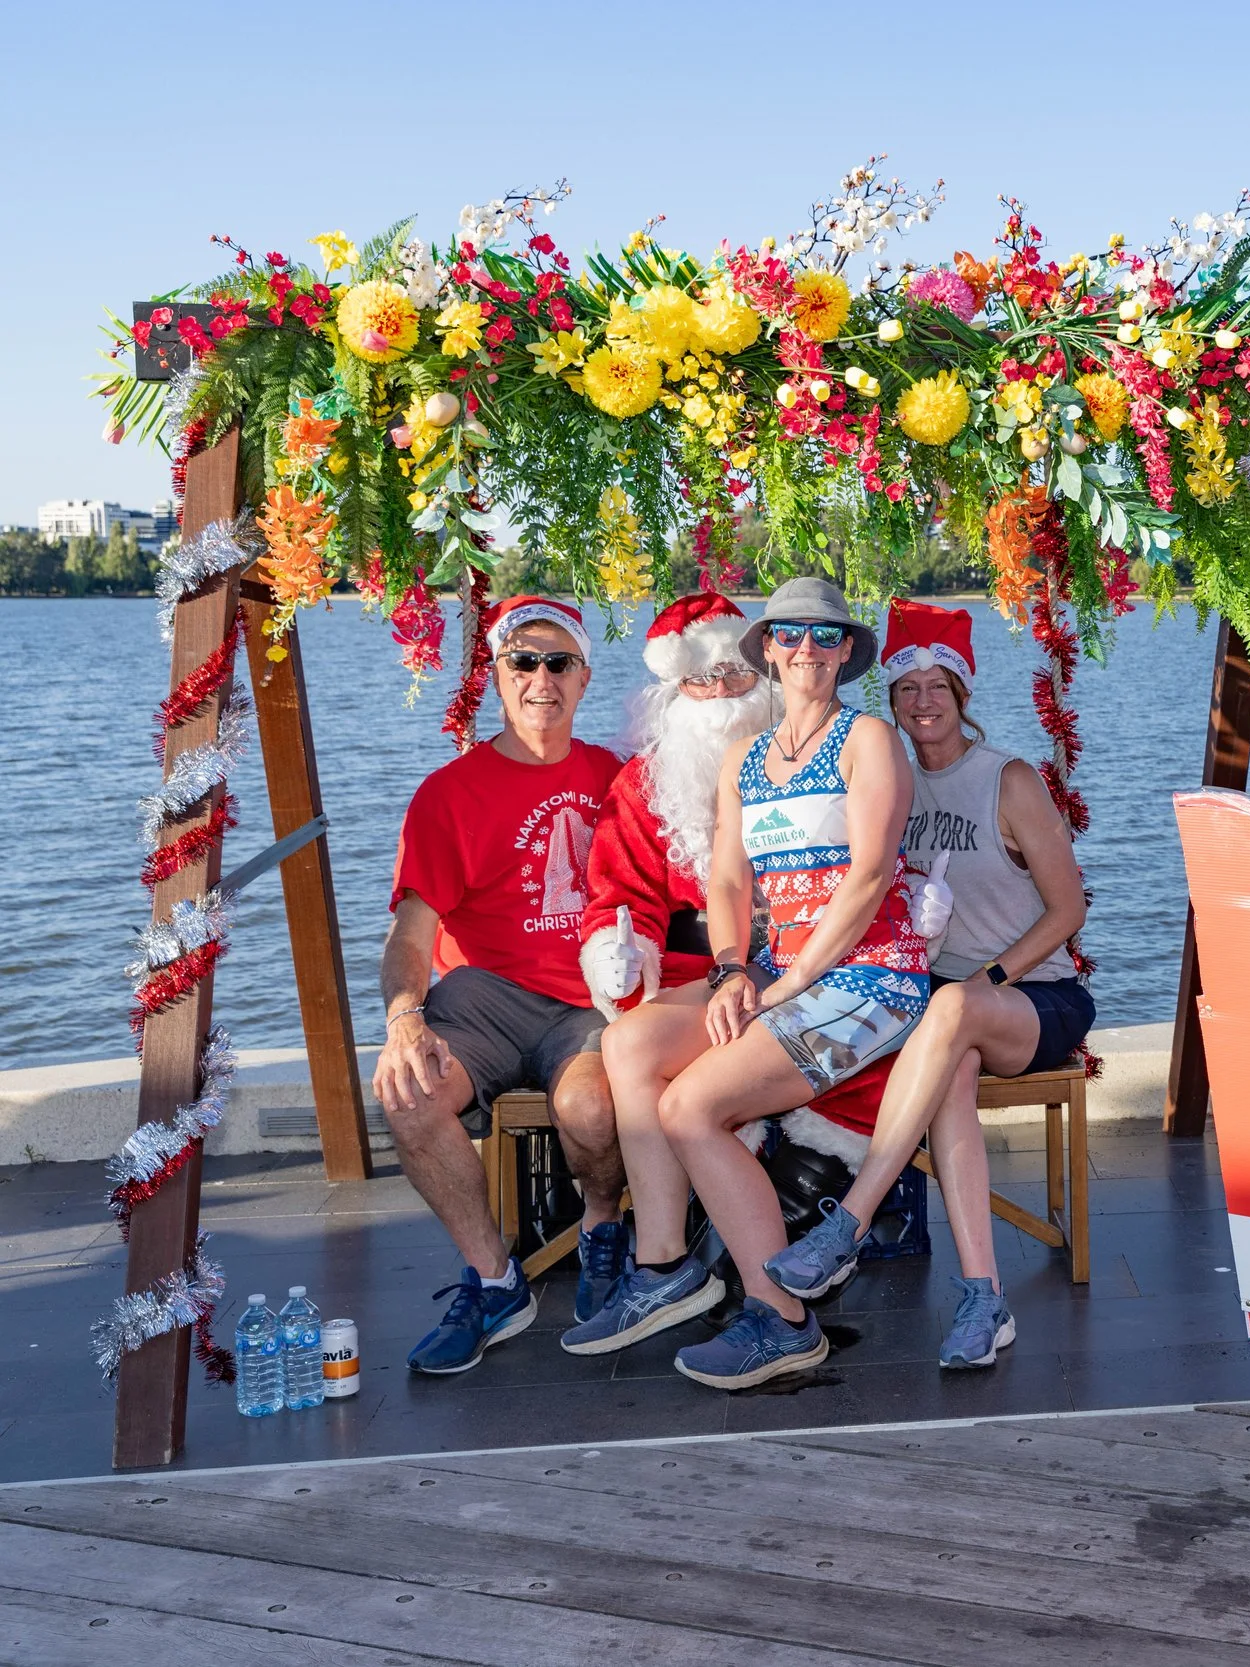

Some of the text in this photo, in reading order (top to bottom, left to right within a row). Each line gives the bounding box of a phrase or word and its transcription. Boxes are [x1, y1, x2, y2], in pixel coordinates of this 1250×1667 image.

[536, 606, 568, 623] Santa
[568, 619, 583, 639] Run
[514, 790, 576, 849] NAKATOMI
[745, 828, 810, 850] THE TRAIL CO.
[930, 811, 978, 851] YORK
[523, 912, 585, 933] CHRISTM
[575, 928, 582, 943] 1
[323, 1349, 352, 1362] avla
